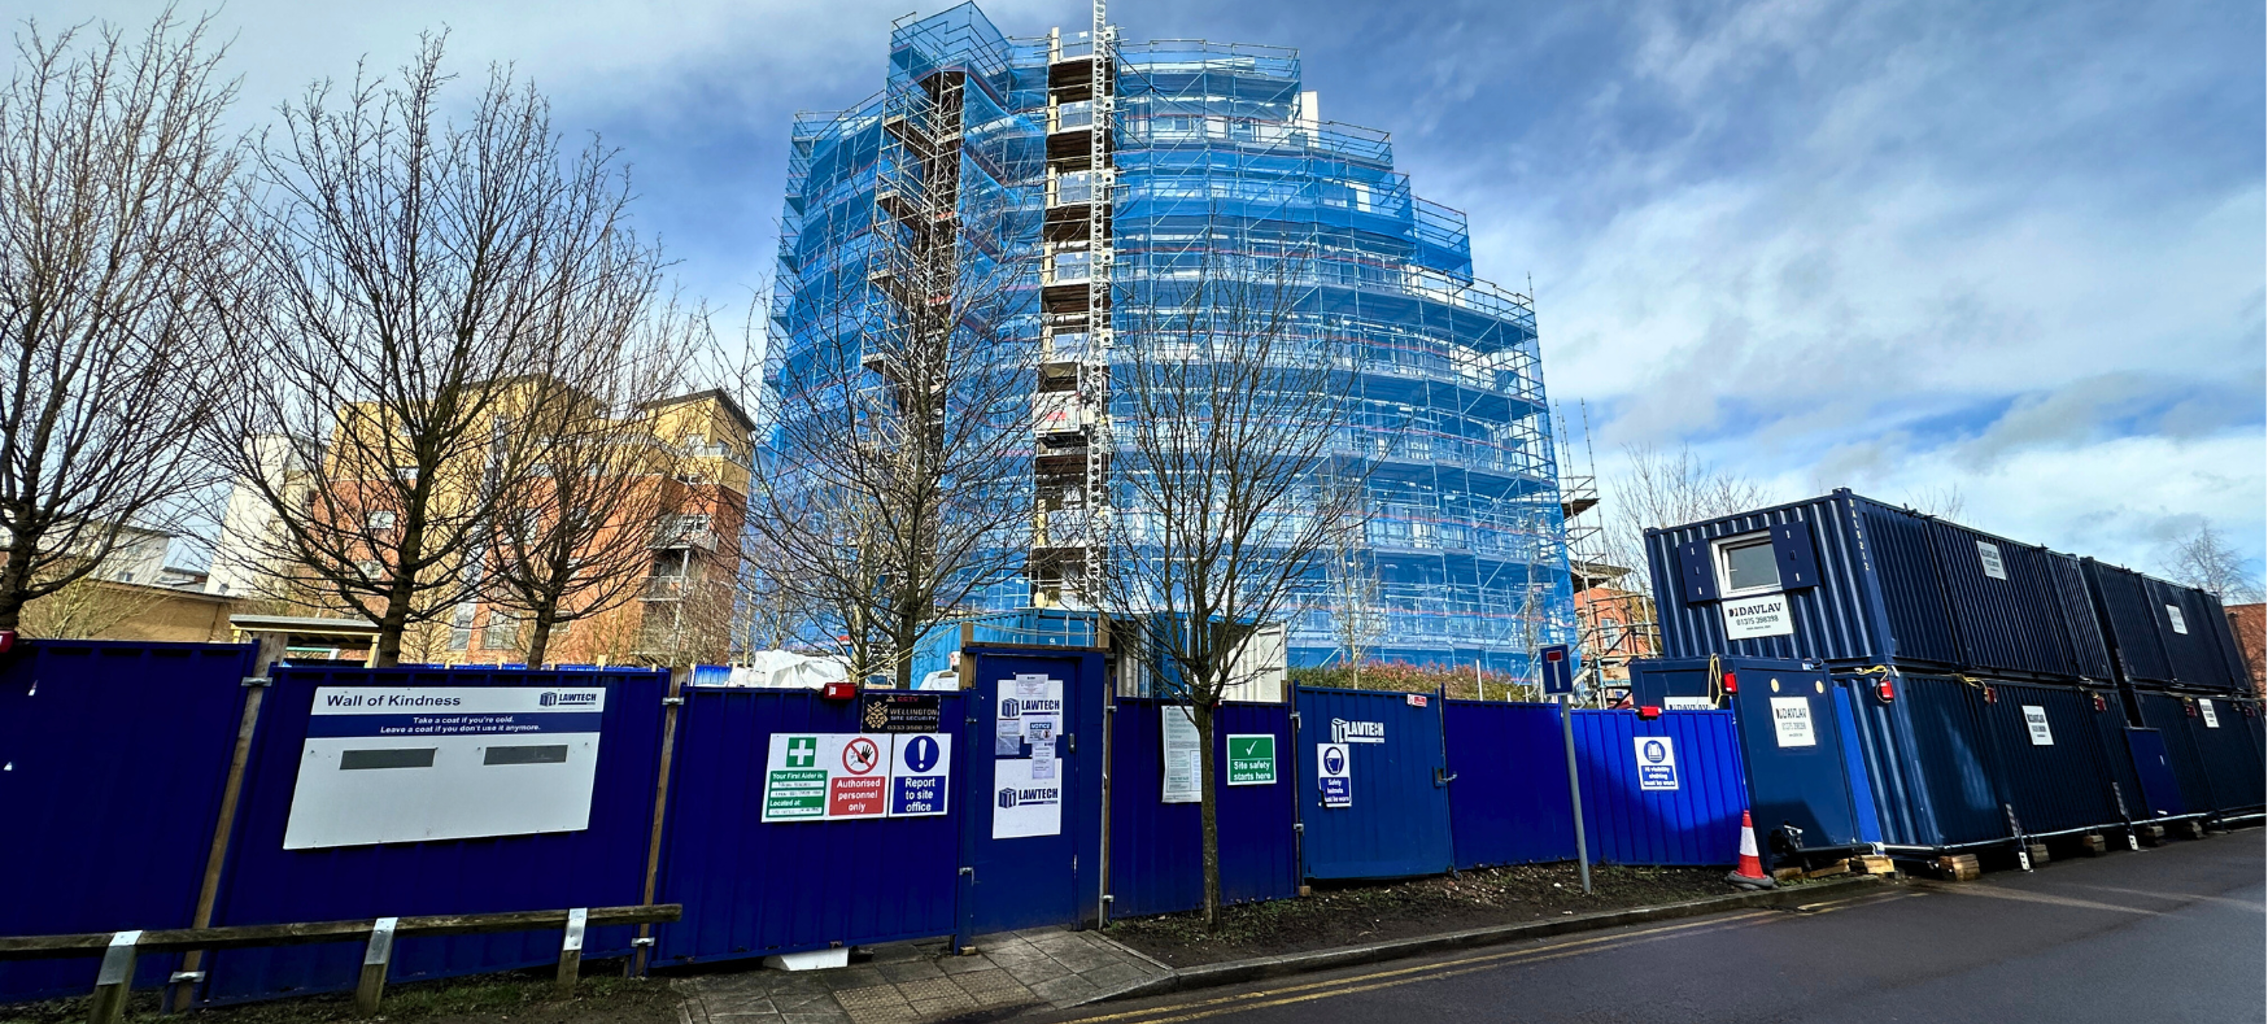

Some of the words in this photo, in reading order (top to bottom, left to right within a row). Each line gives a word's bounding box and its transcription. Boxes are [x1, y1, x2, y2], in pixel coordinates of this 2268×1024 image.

[327, 695, 362, 706] Wall
[367, 695, 385, 706] of
[388, 695, 461, 706] Kindness
[559, 693, 597, 701] LAWTECH
[1021, 700, 1060, 711] LAWTECH
[461, 716, 468, 724] if
[468, 716, 494, 725] you're
[414, 725, 433, 733] coat
[441, 726, 458, 734] you
[505, 725, 541, 733] anymore.
[1234, 761, 1248, 770] Site
[1249, 761, 1271, 771] safety
[772, 772, 786, 780] Your
[1233, 773, 1254, 781] starts
[1255, 772, 1271, 780] here
[837, 778, 881, 788] Authorised
[905, 777, 936, 789] Report
[838, 790, 878, 801] personnel
[905, 790, 915, 800] to
[917, 790, 934, 800] site
[1018, 788, 1058, 800] LAWTECH
[769, 799, 793, 807] Located
[848, 802, 866, 812] only
[906, 801, 932, 812] office
